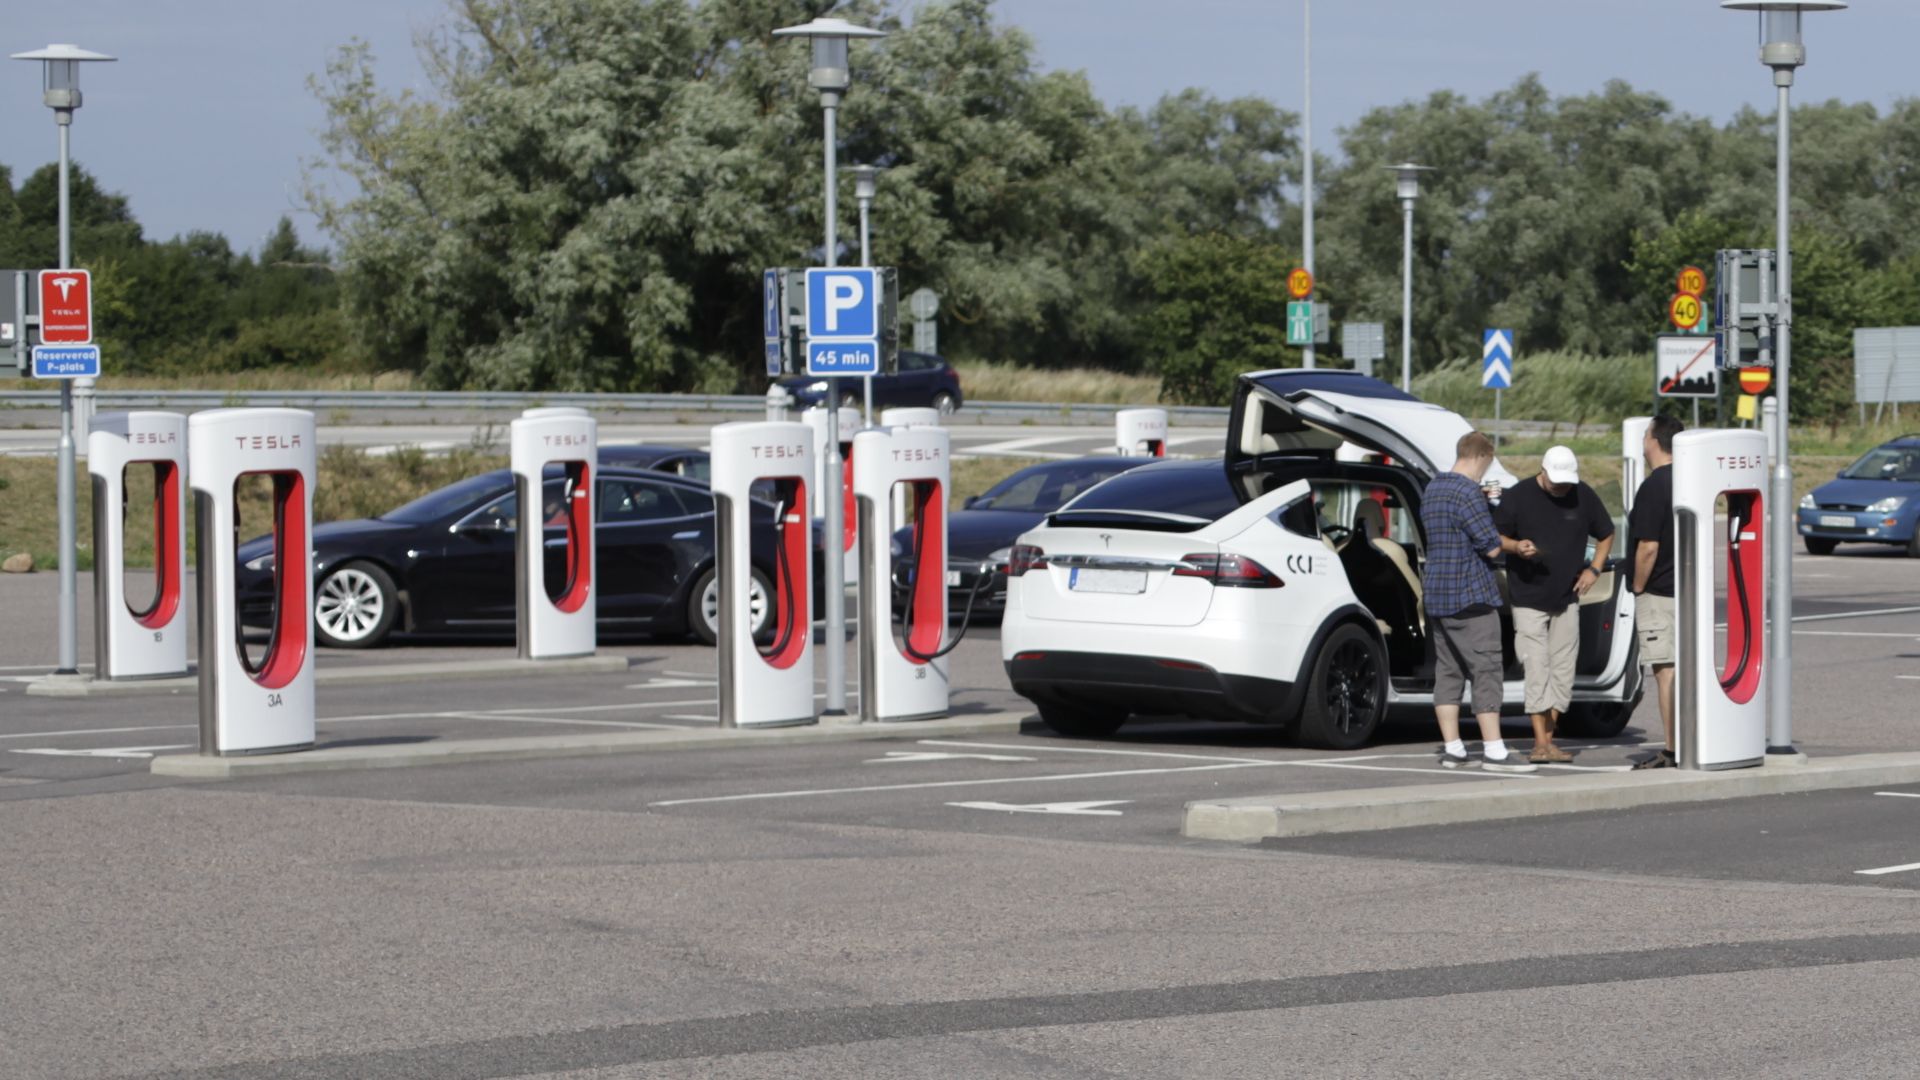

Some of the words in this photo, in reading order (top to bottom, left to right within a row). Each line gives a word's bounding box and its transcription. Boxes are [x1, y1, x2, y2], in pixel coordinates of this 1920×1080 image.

[1682, 275, 1700, 290] 110
[825, 275, 863, 331] P
[1675, 301, 1697, 320] 40
[815, 350, 837, 365] 45
[842, 350, 870, 365] min
[47, 362, 85, 373] P-plats
[124, 432, 176, 443] TESLA
[235, 435, 301, 449] TESLA
[543, 434, 588, 446] TESLA
[751, 445, 804, 458] TESLA
[891, 448, 940, 461] TESLA
[1716, 455, 1761, 469] TESLA
[268, 693, 283, 707] 3A
